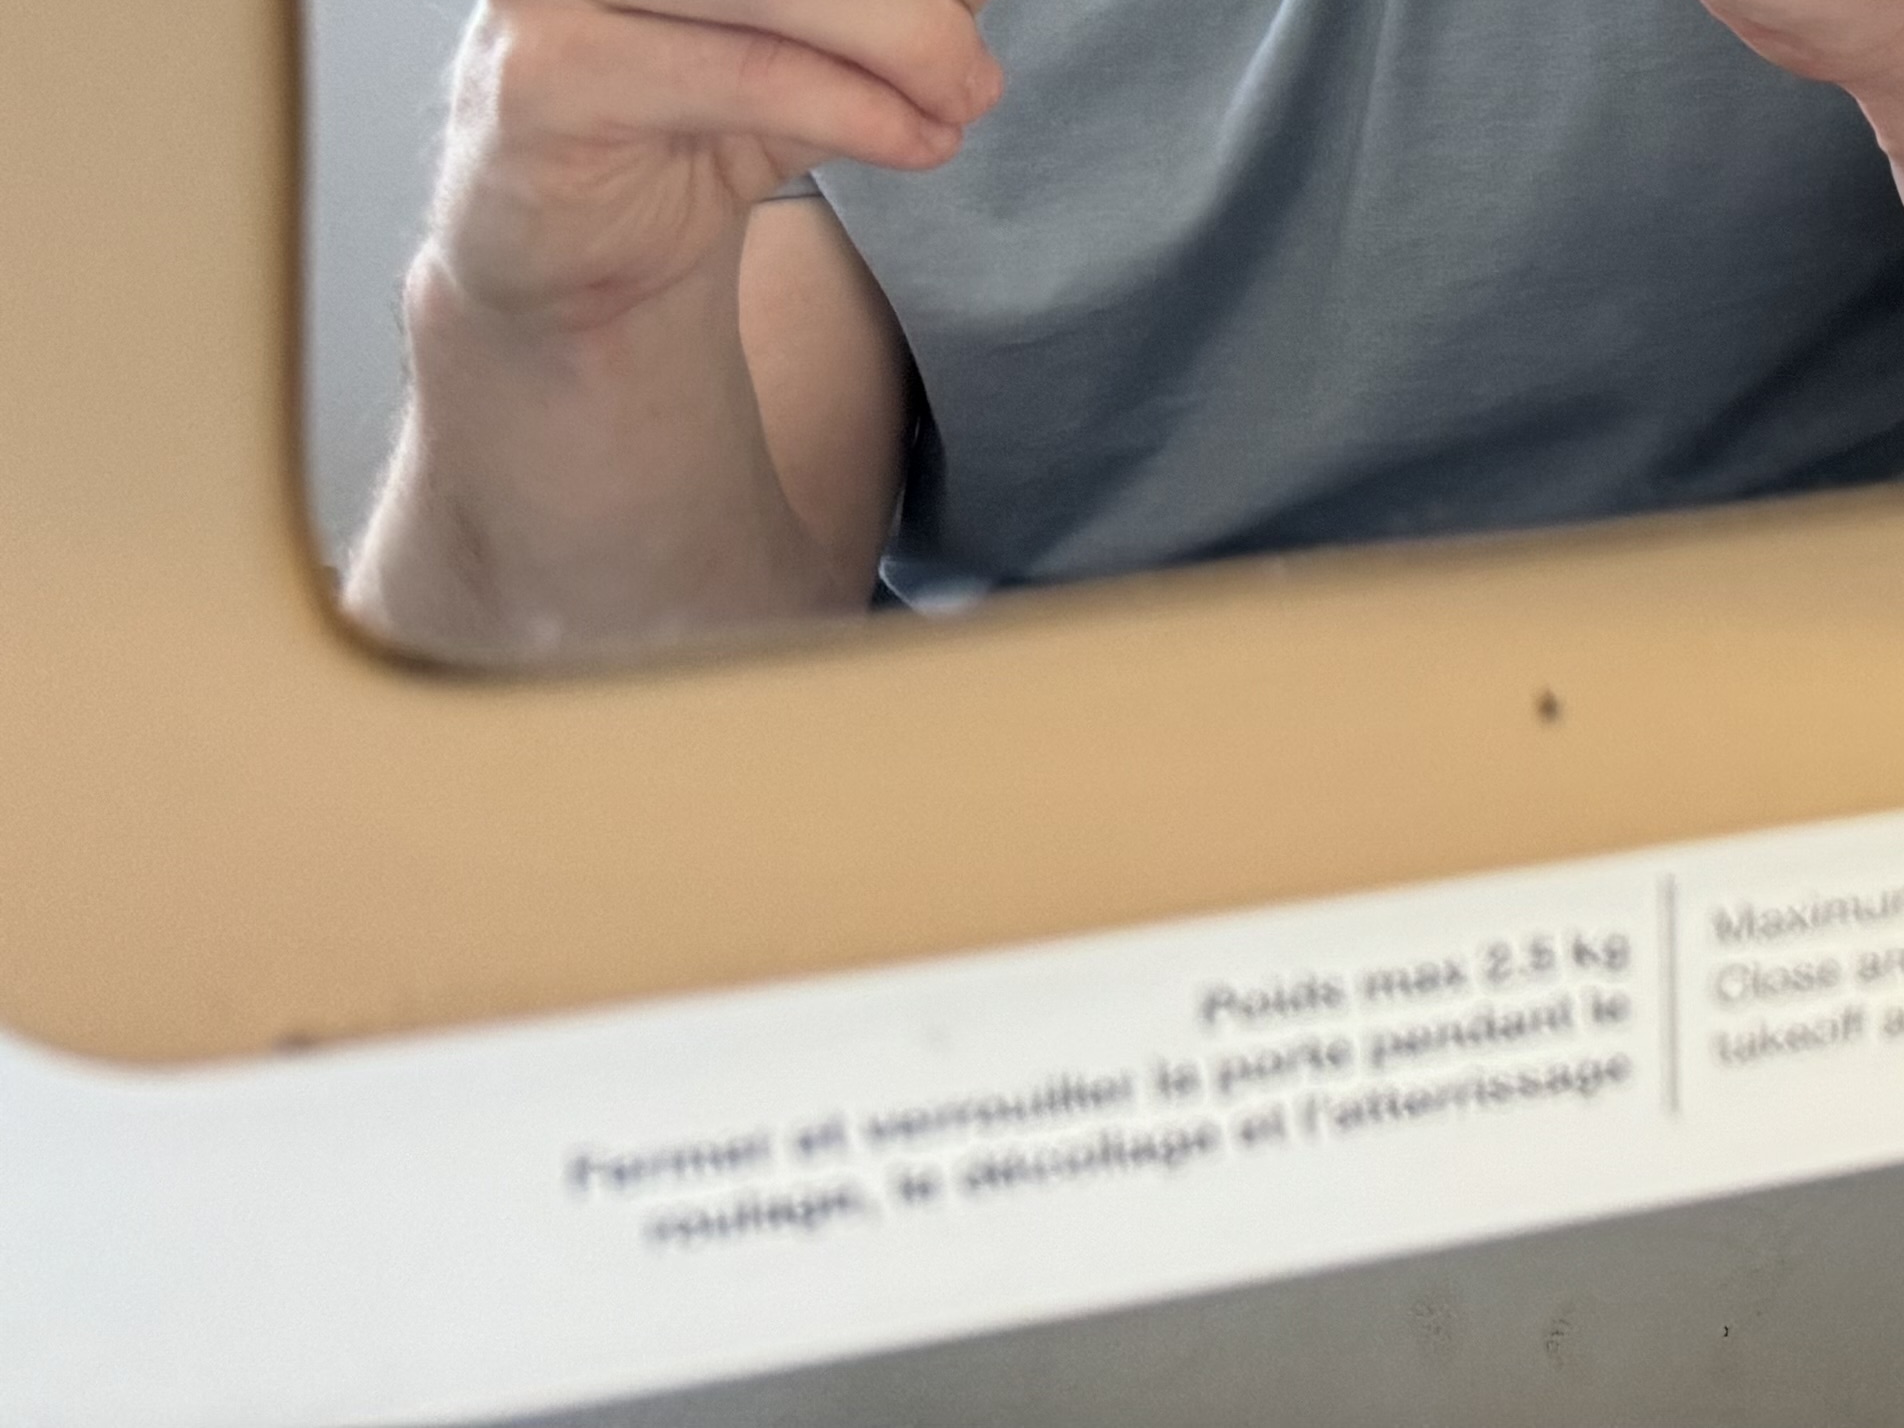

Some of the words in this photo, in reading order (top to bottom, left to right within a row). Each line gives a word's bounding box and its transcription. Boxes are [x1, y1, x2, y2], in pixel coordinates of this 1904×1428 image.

[1203, 978, 1346, 1034] Poids
[1362, 956, 1467, 1004] max
[1570, 930, 1631, 975] kg
[1715, 952, 1841, 1005] Close
[1715, 1002, 1868, 1068] takeoff
[566, 1134, 772, 1199] Fermer
[1219, 1034, 1354, 1097] porte
[1369, 996, 1572, 1070] pendant
